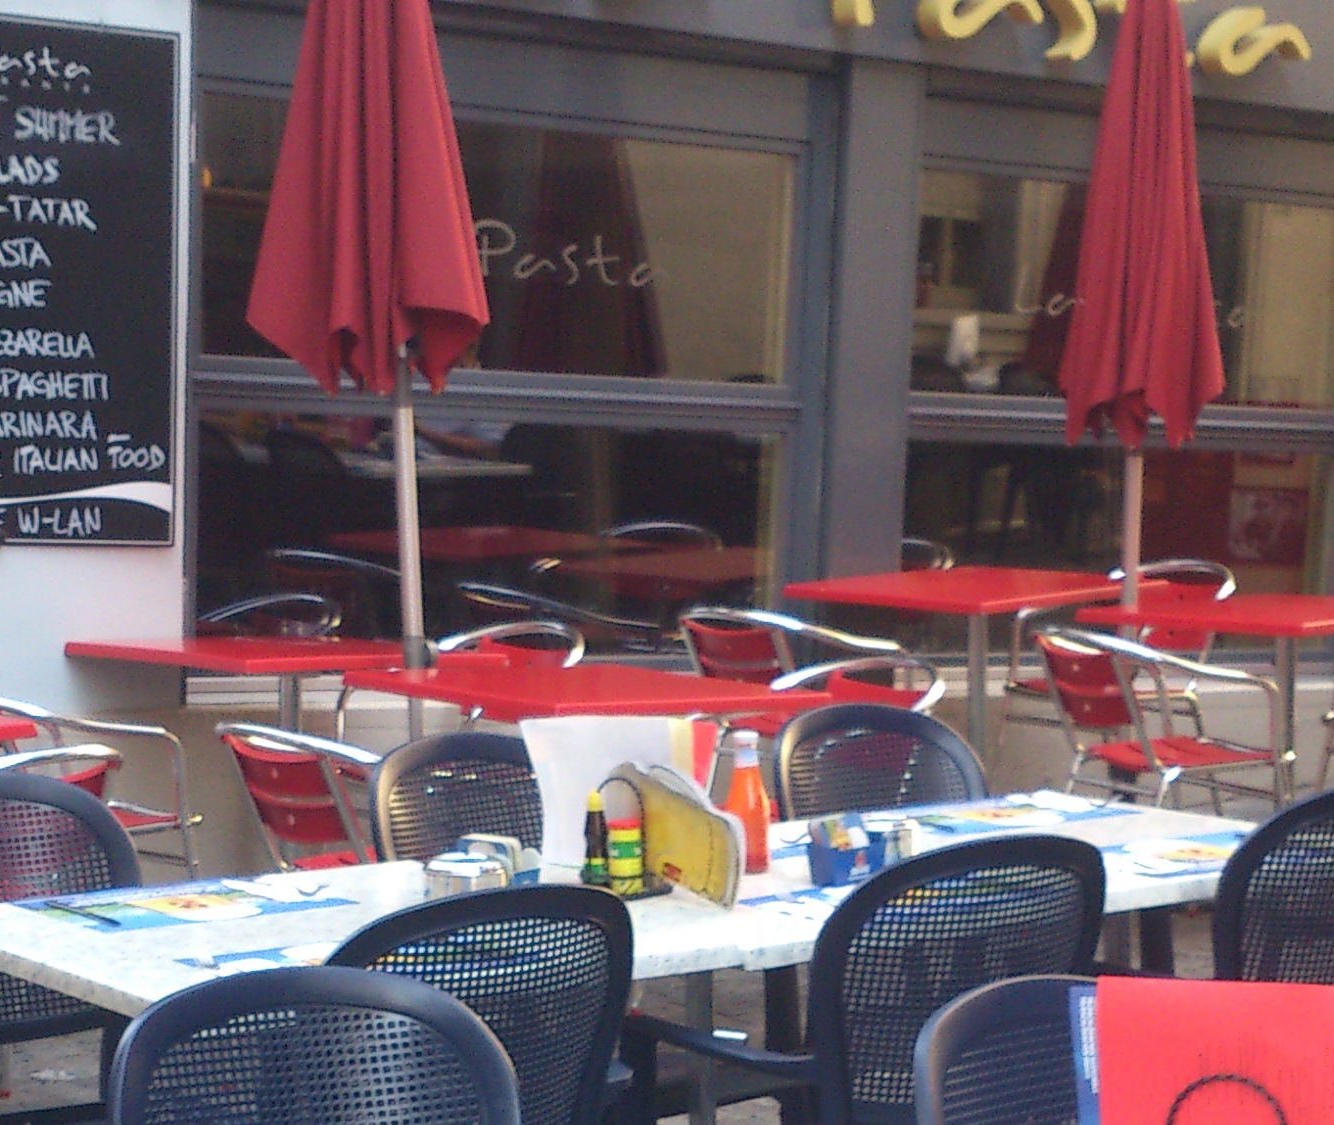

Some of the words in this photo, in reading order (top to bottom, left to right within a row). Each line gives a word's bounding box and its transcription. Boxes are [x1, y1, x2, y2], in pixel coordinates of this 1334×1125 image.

[13, 445, 98, 472] ITALIAN
[107, 433, 165, 471] FOOD
[18, 507, 101, 534] W-LAN
